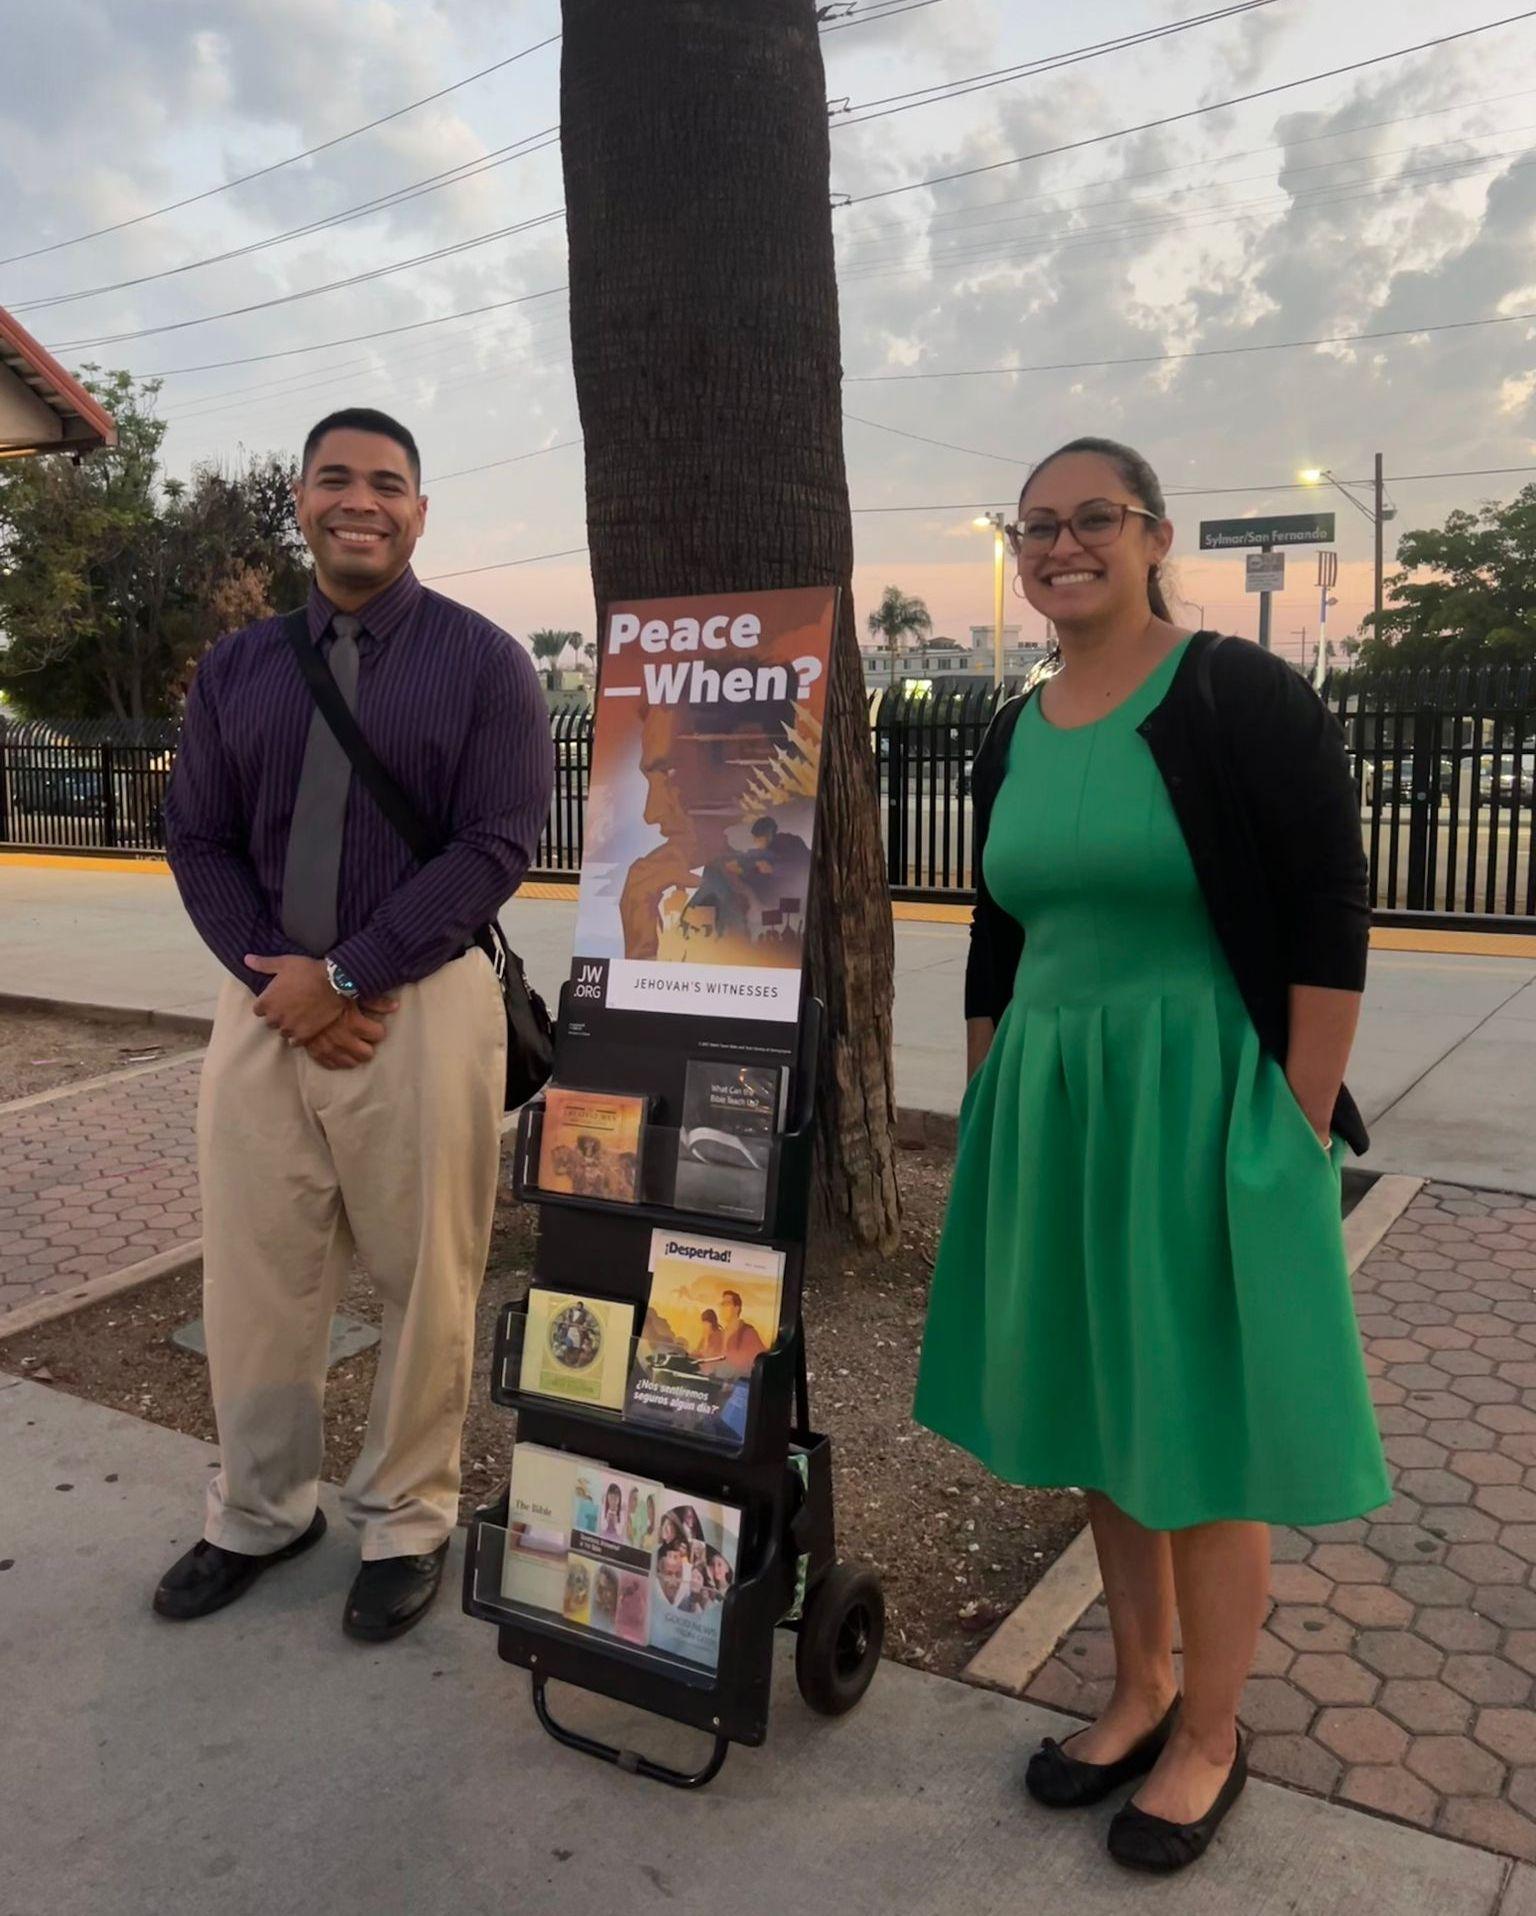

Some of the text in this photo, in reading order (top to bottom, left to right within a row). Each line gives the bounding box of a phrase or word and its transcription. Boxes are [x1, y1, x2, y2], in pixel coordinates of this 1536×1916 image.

[1205, 526, 1328, 547] Sylmar/San Fernando
[608, 613, 761, 655] Peace
[577, 965, 603, 983] JW
[573, 984, 601, 999] .ORG
[634, 978, 779, 998] JEHOVAH'S WITNESSES
[711, 1084, 728, 1094] What
[665, 1241, 732, 1263] ¡Despertad!
[633, 1391, 668, 1405] seguros
[636, 1379, 709, 1401] ¿Nos sentiremos
